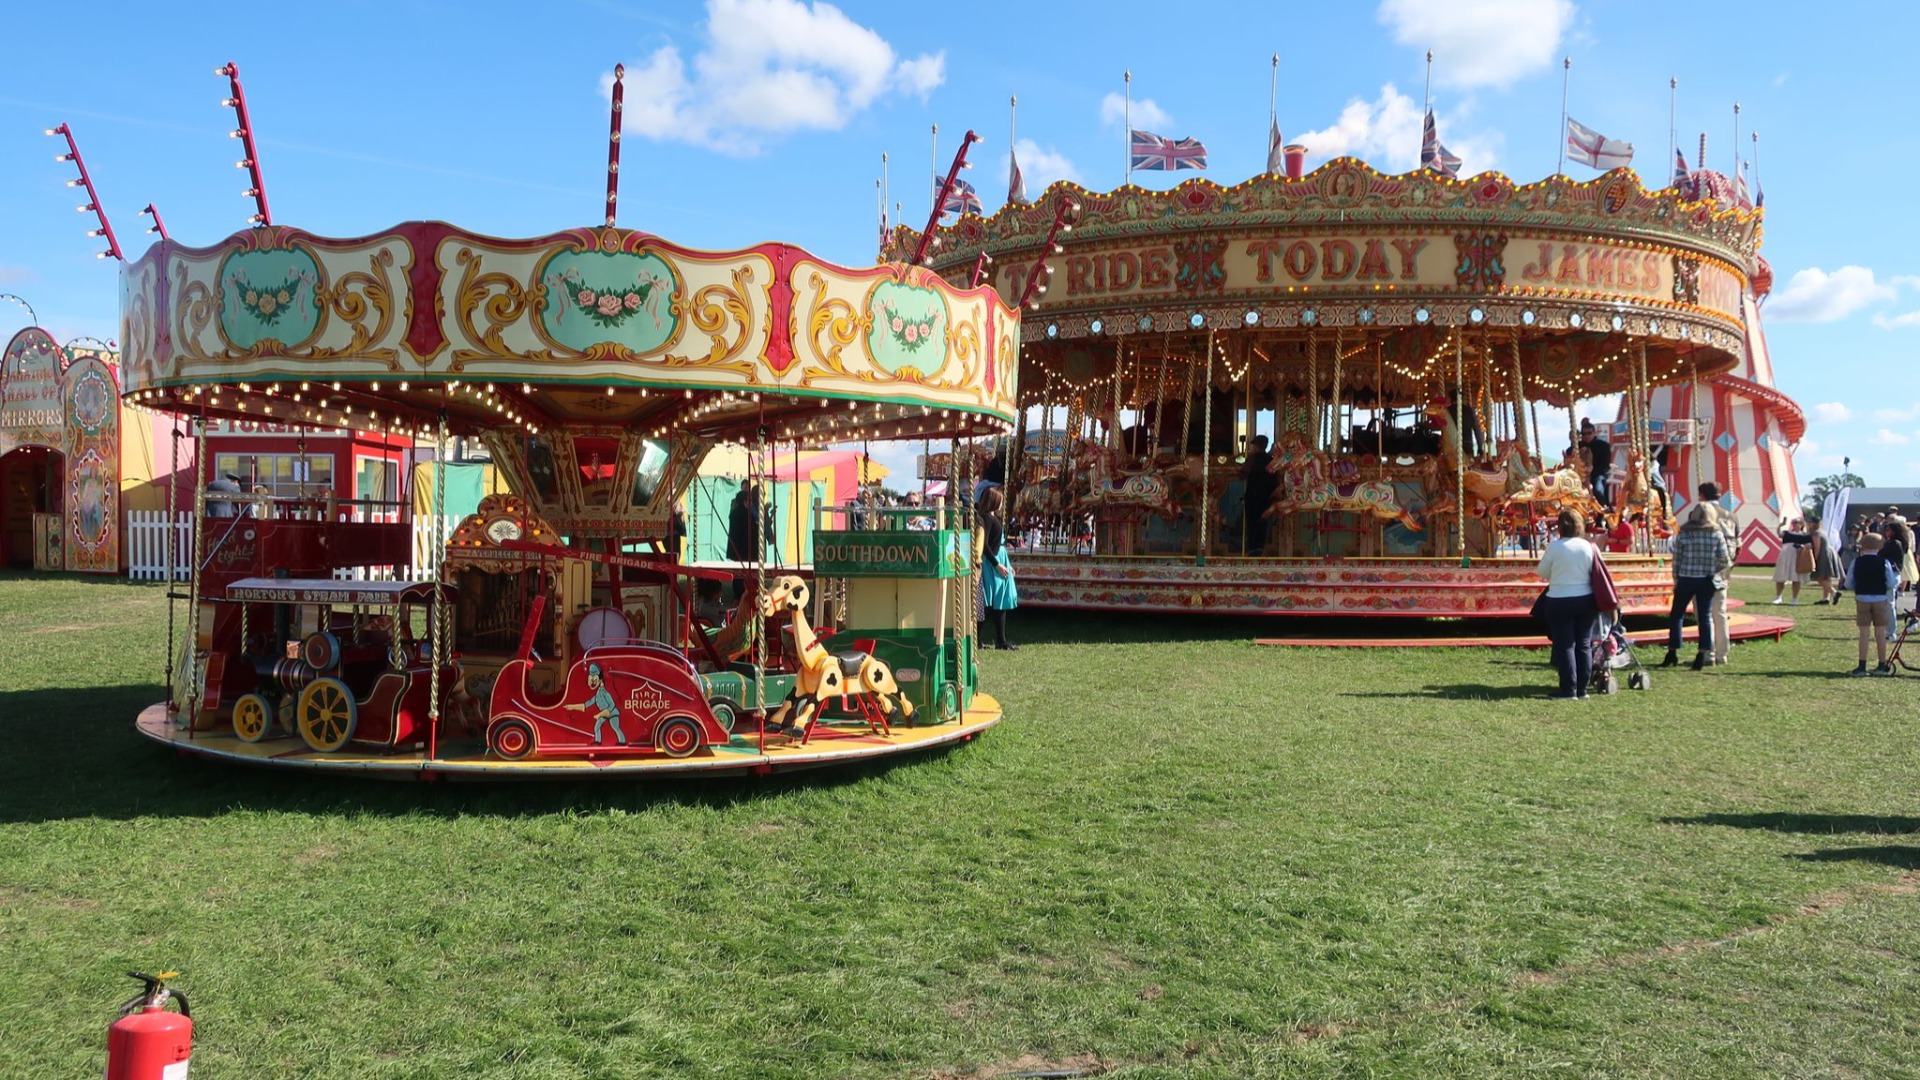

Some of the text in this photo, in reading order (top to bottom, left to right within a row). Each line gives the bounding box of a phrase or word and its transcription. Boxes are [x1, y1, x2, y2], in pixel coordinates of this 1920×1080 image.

[1005, 238, 1430, 303] TO RIDE TODAY
[1522, 242, 1663, 291] JAMES
[1, 408, 62, 427] MIRRORS
[580, 551, 654, 570] FIRE BRIGADE
[815, 544, 929, 563] SOUTHDOWN
[234, 588, 390, 603] HORTON'S STEAM FAIR
[624, 700, 671, 709] BRIGADE
[635, 691, 656, 699] FIRE
